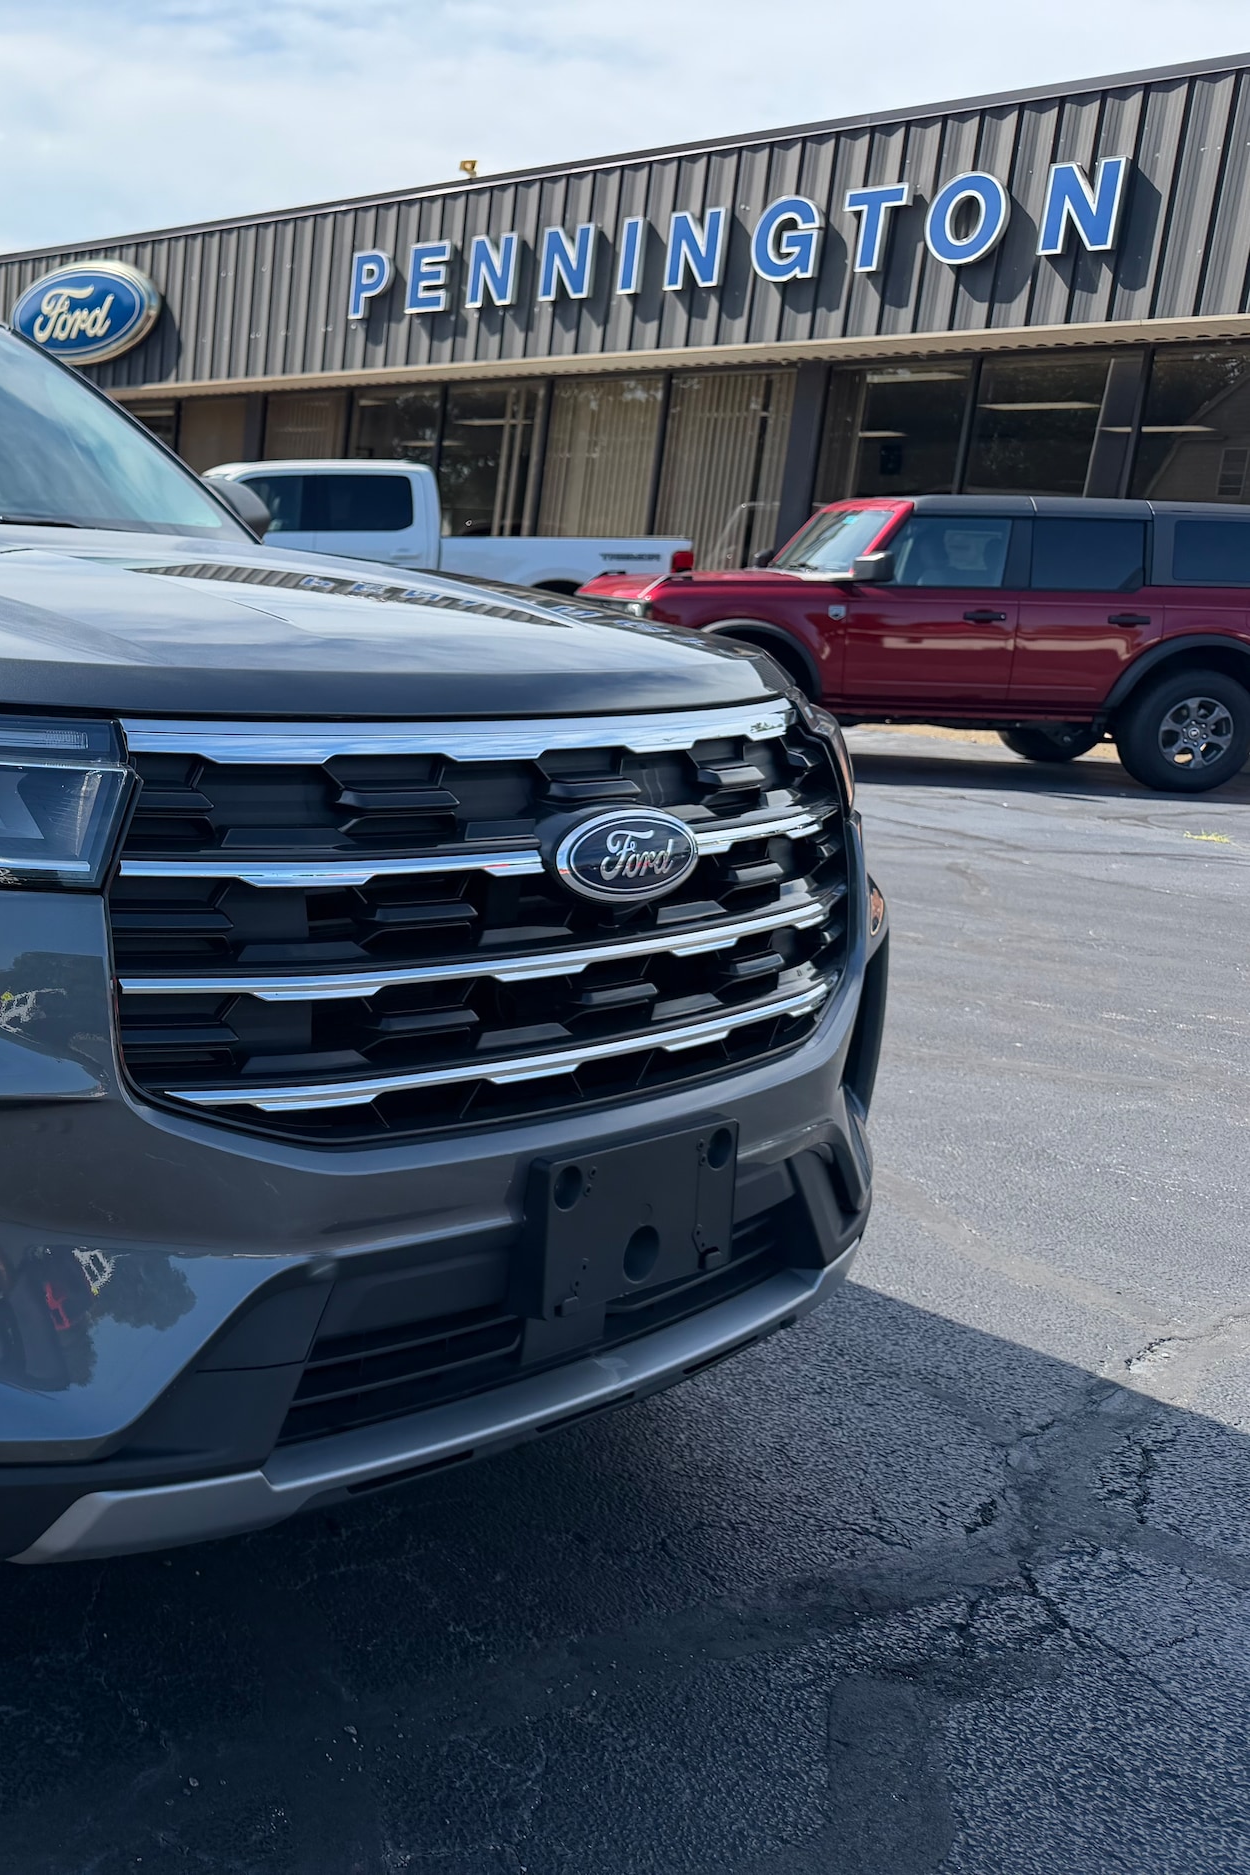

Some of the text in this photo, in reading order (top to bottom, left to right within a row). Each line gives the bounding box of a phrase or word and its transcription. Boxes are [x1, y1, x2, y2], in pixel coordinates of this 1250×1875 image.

[348, 155, 1132, 321] PENNINGTON
[33, 283, 115, 343] Ford
[600, 829, 674, 881] Ford
